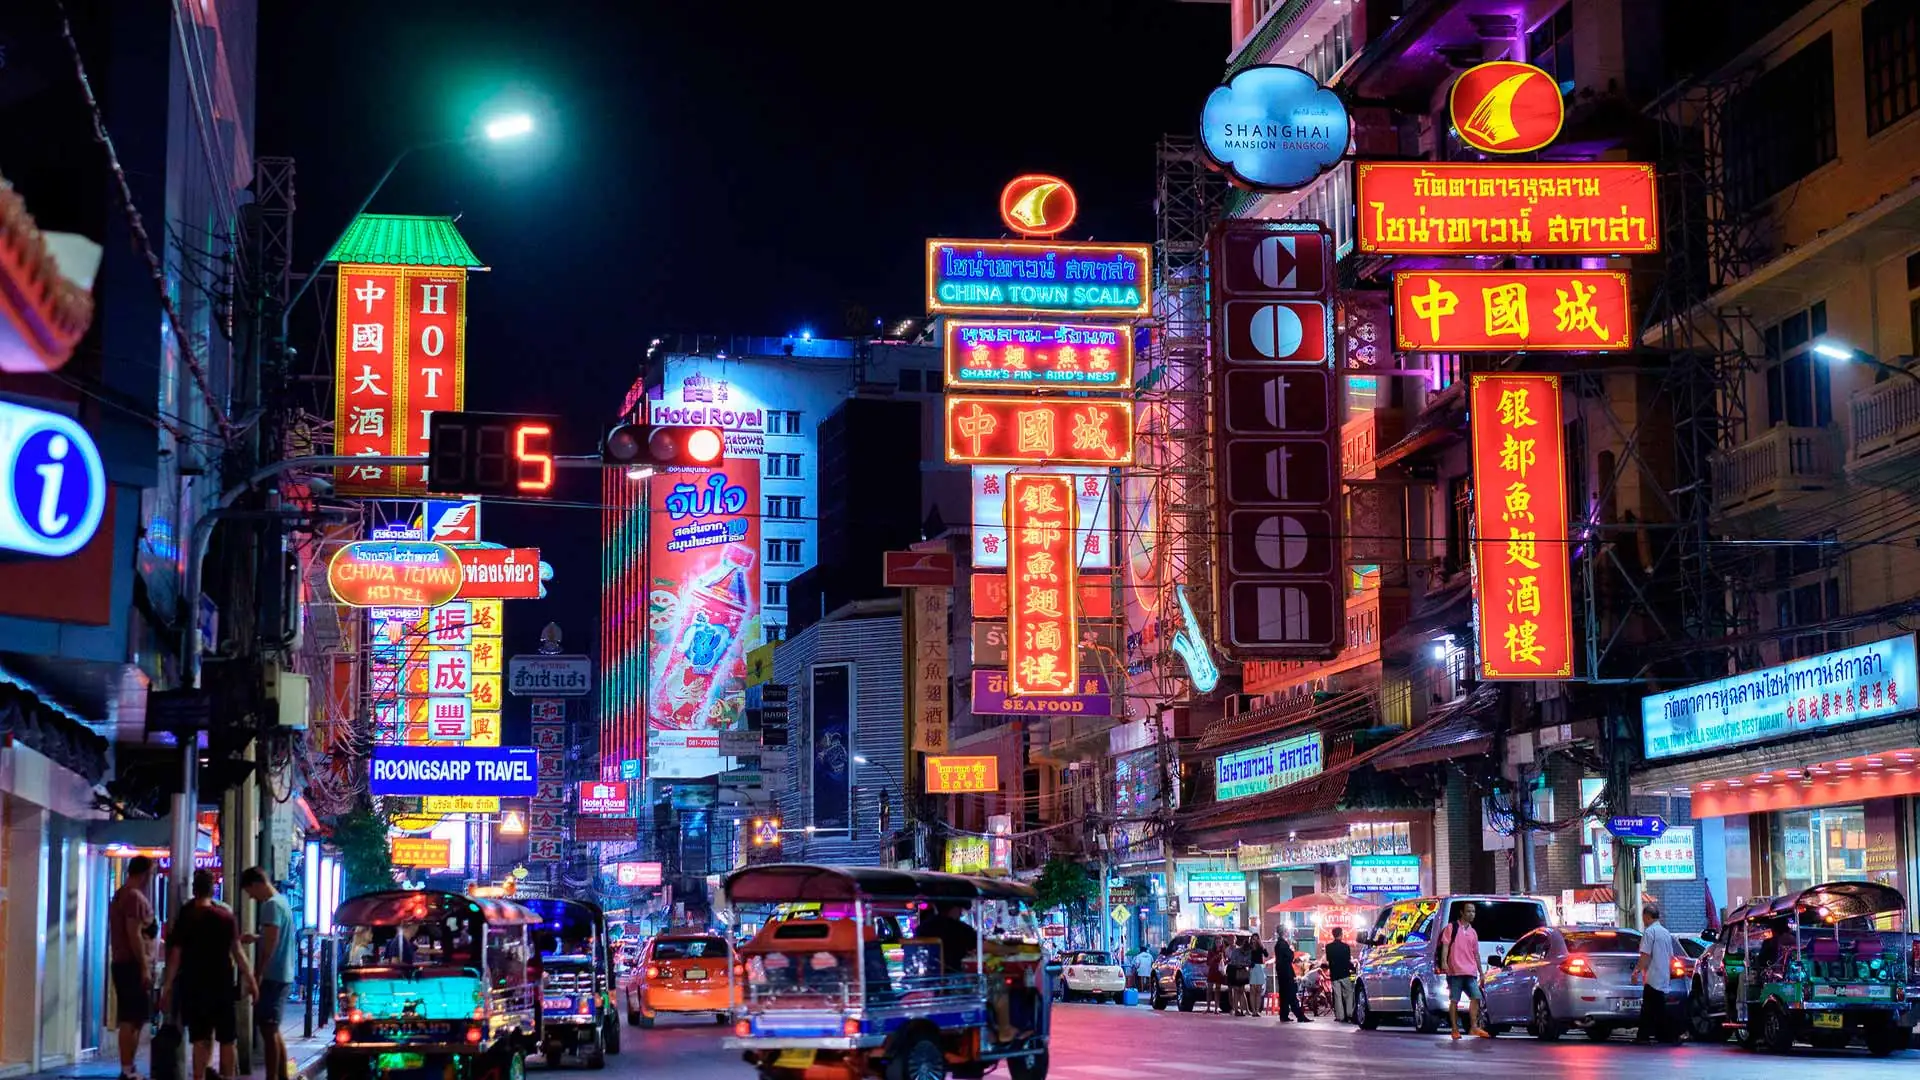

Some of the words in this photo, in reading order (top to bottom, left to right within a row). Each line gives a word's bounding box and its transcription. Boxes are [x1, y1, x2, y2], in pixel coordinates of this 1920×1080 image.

[1224, 123, 1329, 139] SHANGHAI
[1224, 140, 1276, 149] MANSION
[1282, 141, 1330, 151] BANGKOK
[1548, 205, 1647, 242] สกาล่า
[941, 284, 1003, 302] CHINA
[1009, 286, 1068, 302] TOWN
[1073, 287, 1140, 305] SCALA
[1411, 278, 1609, 342] 中國城
[420, 284, 448, 482] HOT
[961, 367, 1010, 380] SHARK'S
[1047, 370, 1084, 381] BIRD'S
[1087, 371, 1117, 382] NEST
[655, 406, 706, 425] Hotel
[710, 408, 762, 428] Royal
[958, 404, 1116, 458] 中國城
[515, 426, 553, 491] 5
[1496, 389, 1546, 666] 銀都魚翅酒樓
[338, 564, 395, 582] CHINA
[404, 565, 456, 584] TOWN
[368, 585, 424, 602] HOTEL
[1018, 484, 1067, 687] 銀都魚翅酒樓
[434, 609, 466, 736] 振成豐
[1002, 699, 1084, 713] SEAFOOD
[1742, 713, 1784, 735] RESTAURANT
[374, 760, 471, 780] ROONGSARP
[475, 761, 532, 781] TRAVEL
[1651, 820, 1660, 831] 2
